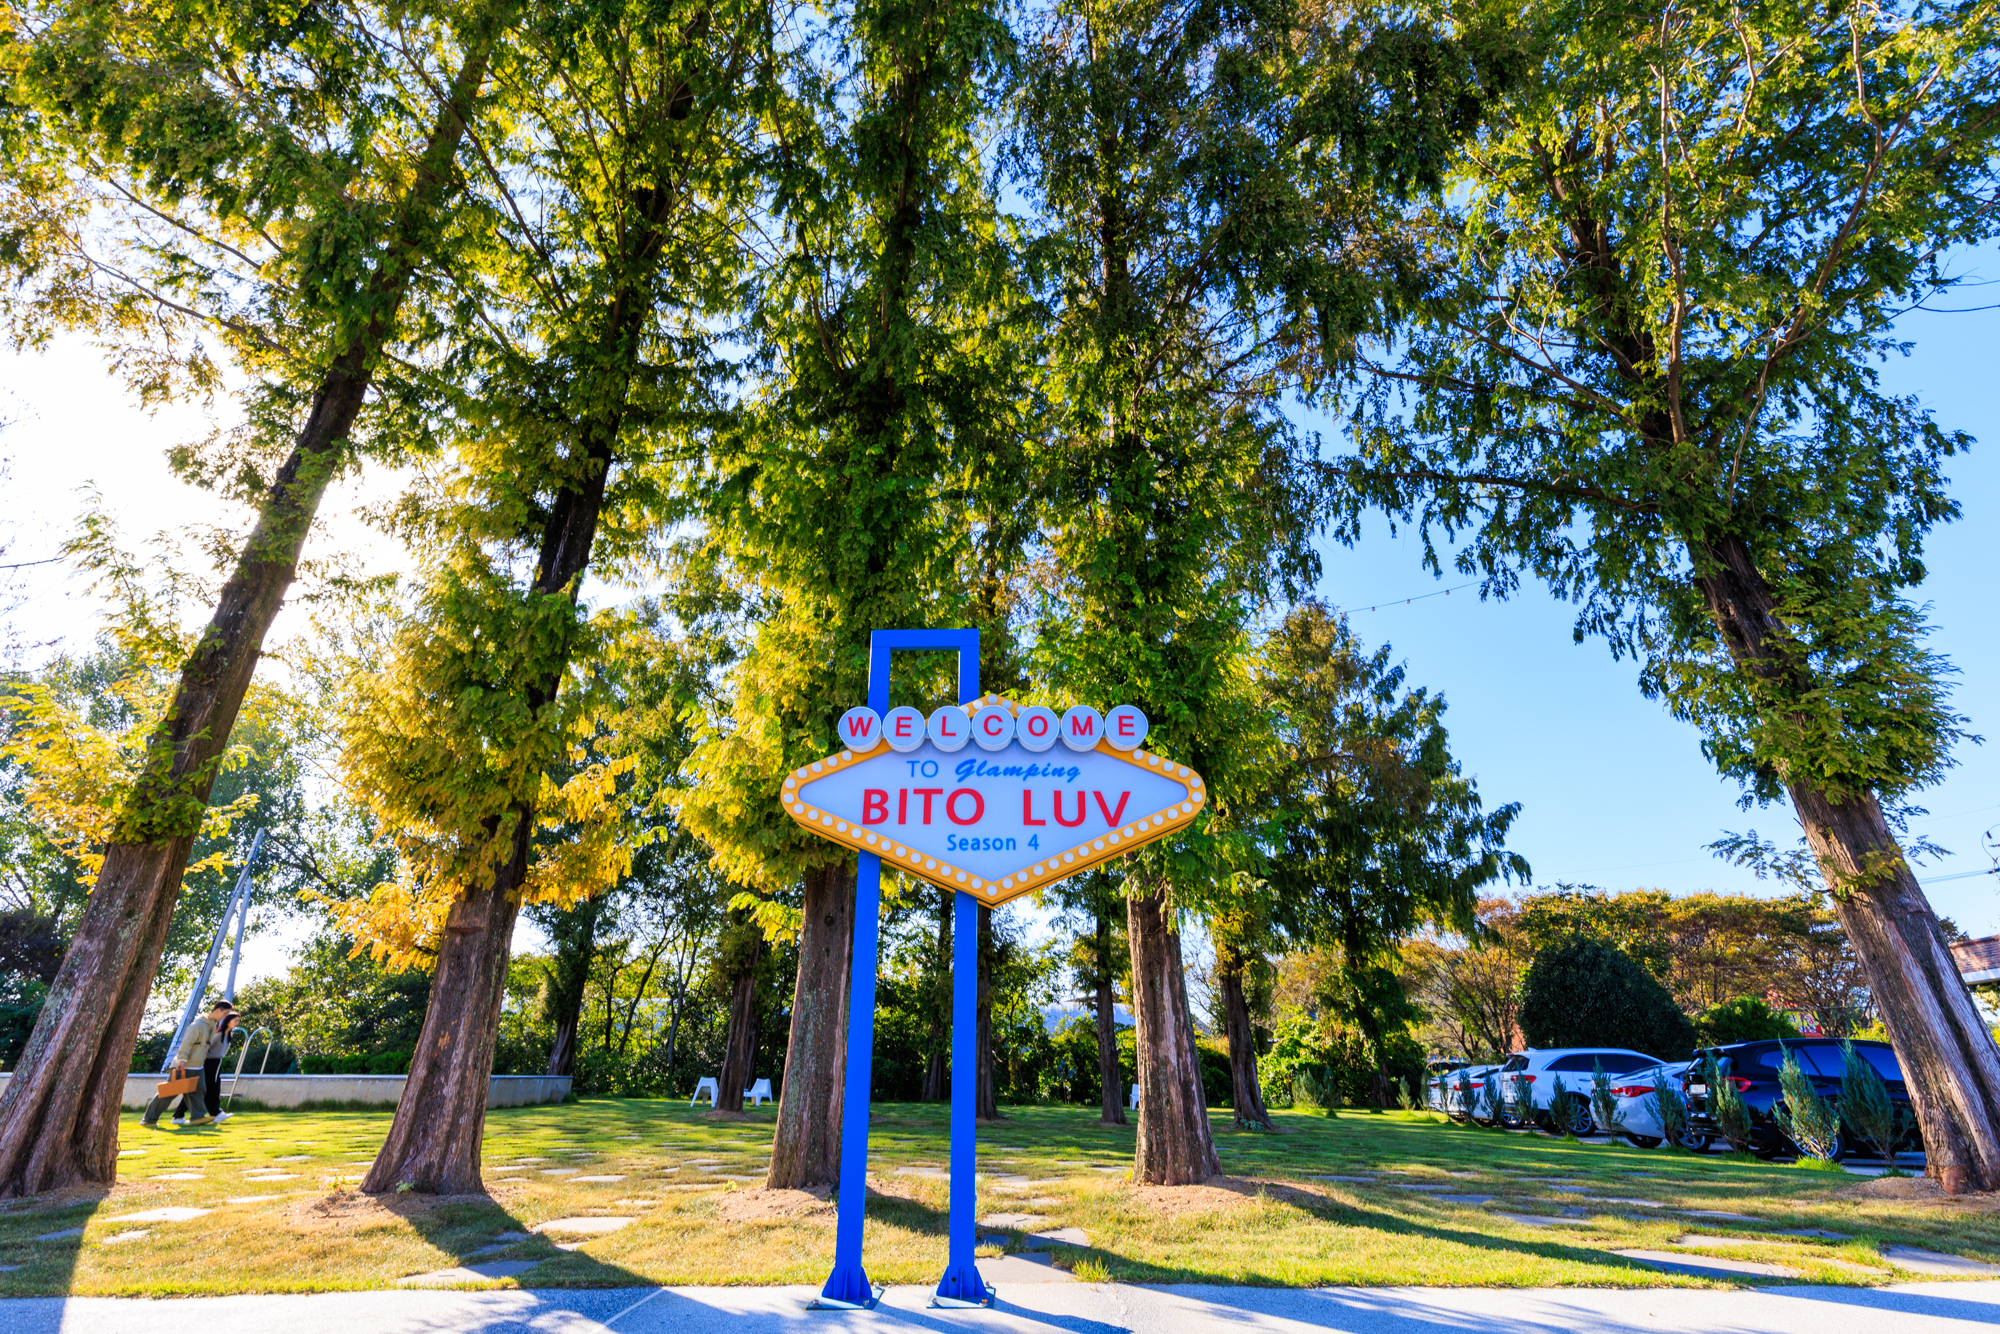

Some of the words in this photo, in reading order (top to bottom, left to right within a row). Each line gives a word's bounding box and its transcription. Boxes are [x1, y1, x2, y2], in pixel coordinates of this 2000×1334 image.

[847, 714, 1135, 737] WELCOME
[906, 759, 939, 778] TO
[954, 758, 1082, 784] Glamping
[861, 788, 985, 826] BITO
[1023, 790, 1131, 828] LUV
[946, 833, 1017, 852] Season
[1026, 832, 1041, 852] 4
